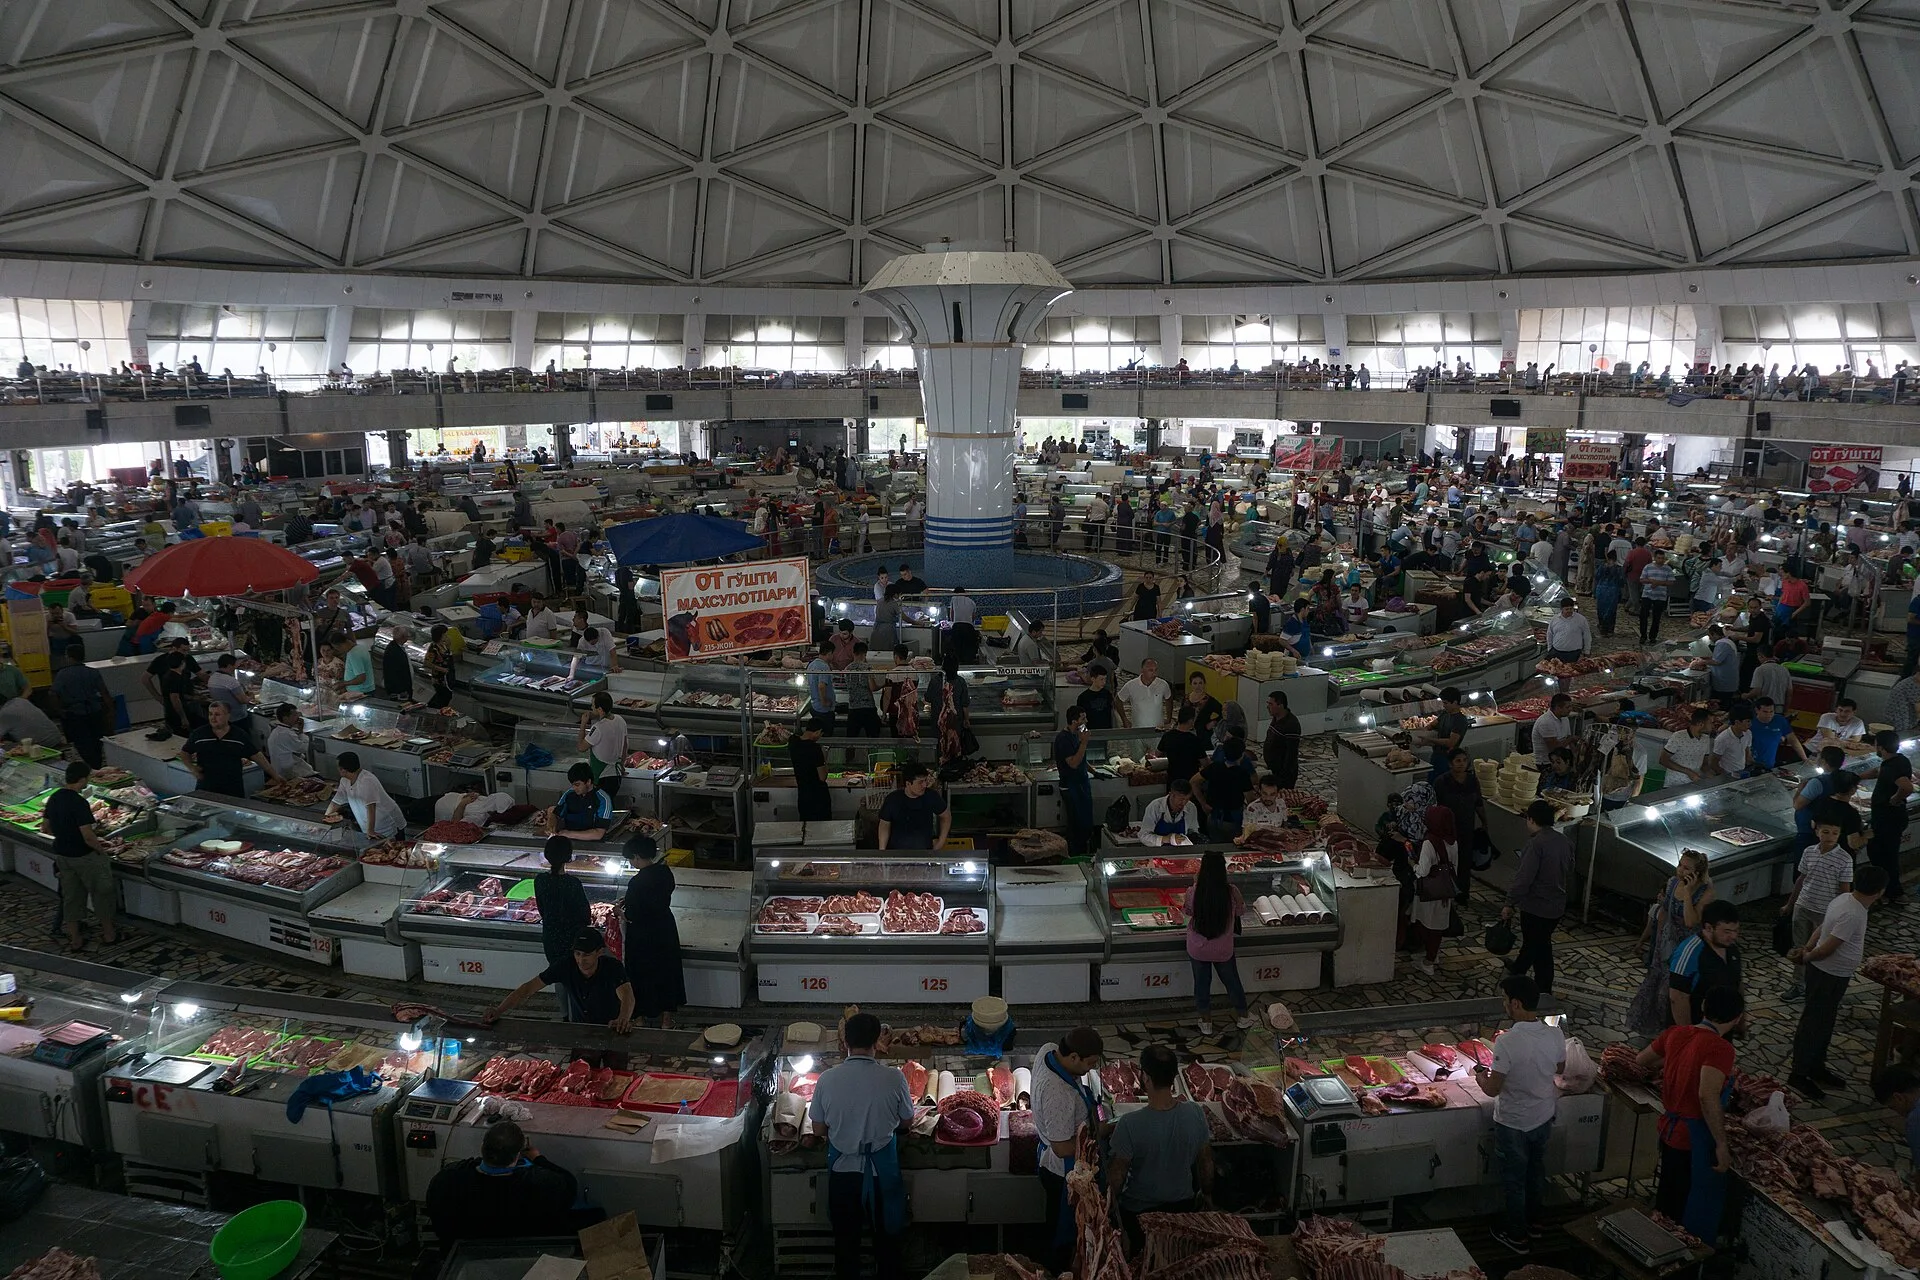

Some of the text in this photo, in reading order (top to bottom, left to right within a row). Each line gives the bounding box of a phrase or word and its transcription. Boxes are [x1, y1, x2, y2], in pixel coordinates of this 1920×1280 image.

[1579, 444, 1591, 453] ОТ
[1811, 447, 1882, 460] ОТ ГЎШТИ
[695, 571, 778, 592] ОТ ГЎШТИ
[677, 587, 797, 611] МАХСУЛОТЛАРИ
[209, 910, 226, 923] 130
[312, 938, 331, 953] 129
[459, 961, 483, 973] 128
[1256, 967, 1281, 980] 123
[800, 977, 828, 990] 126
[921, 978, 948, 991] 125
[1144, 975, 1169, 987] 124
